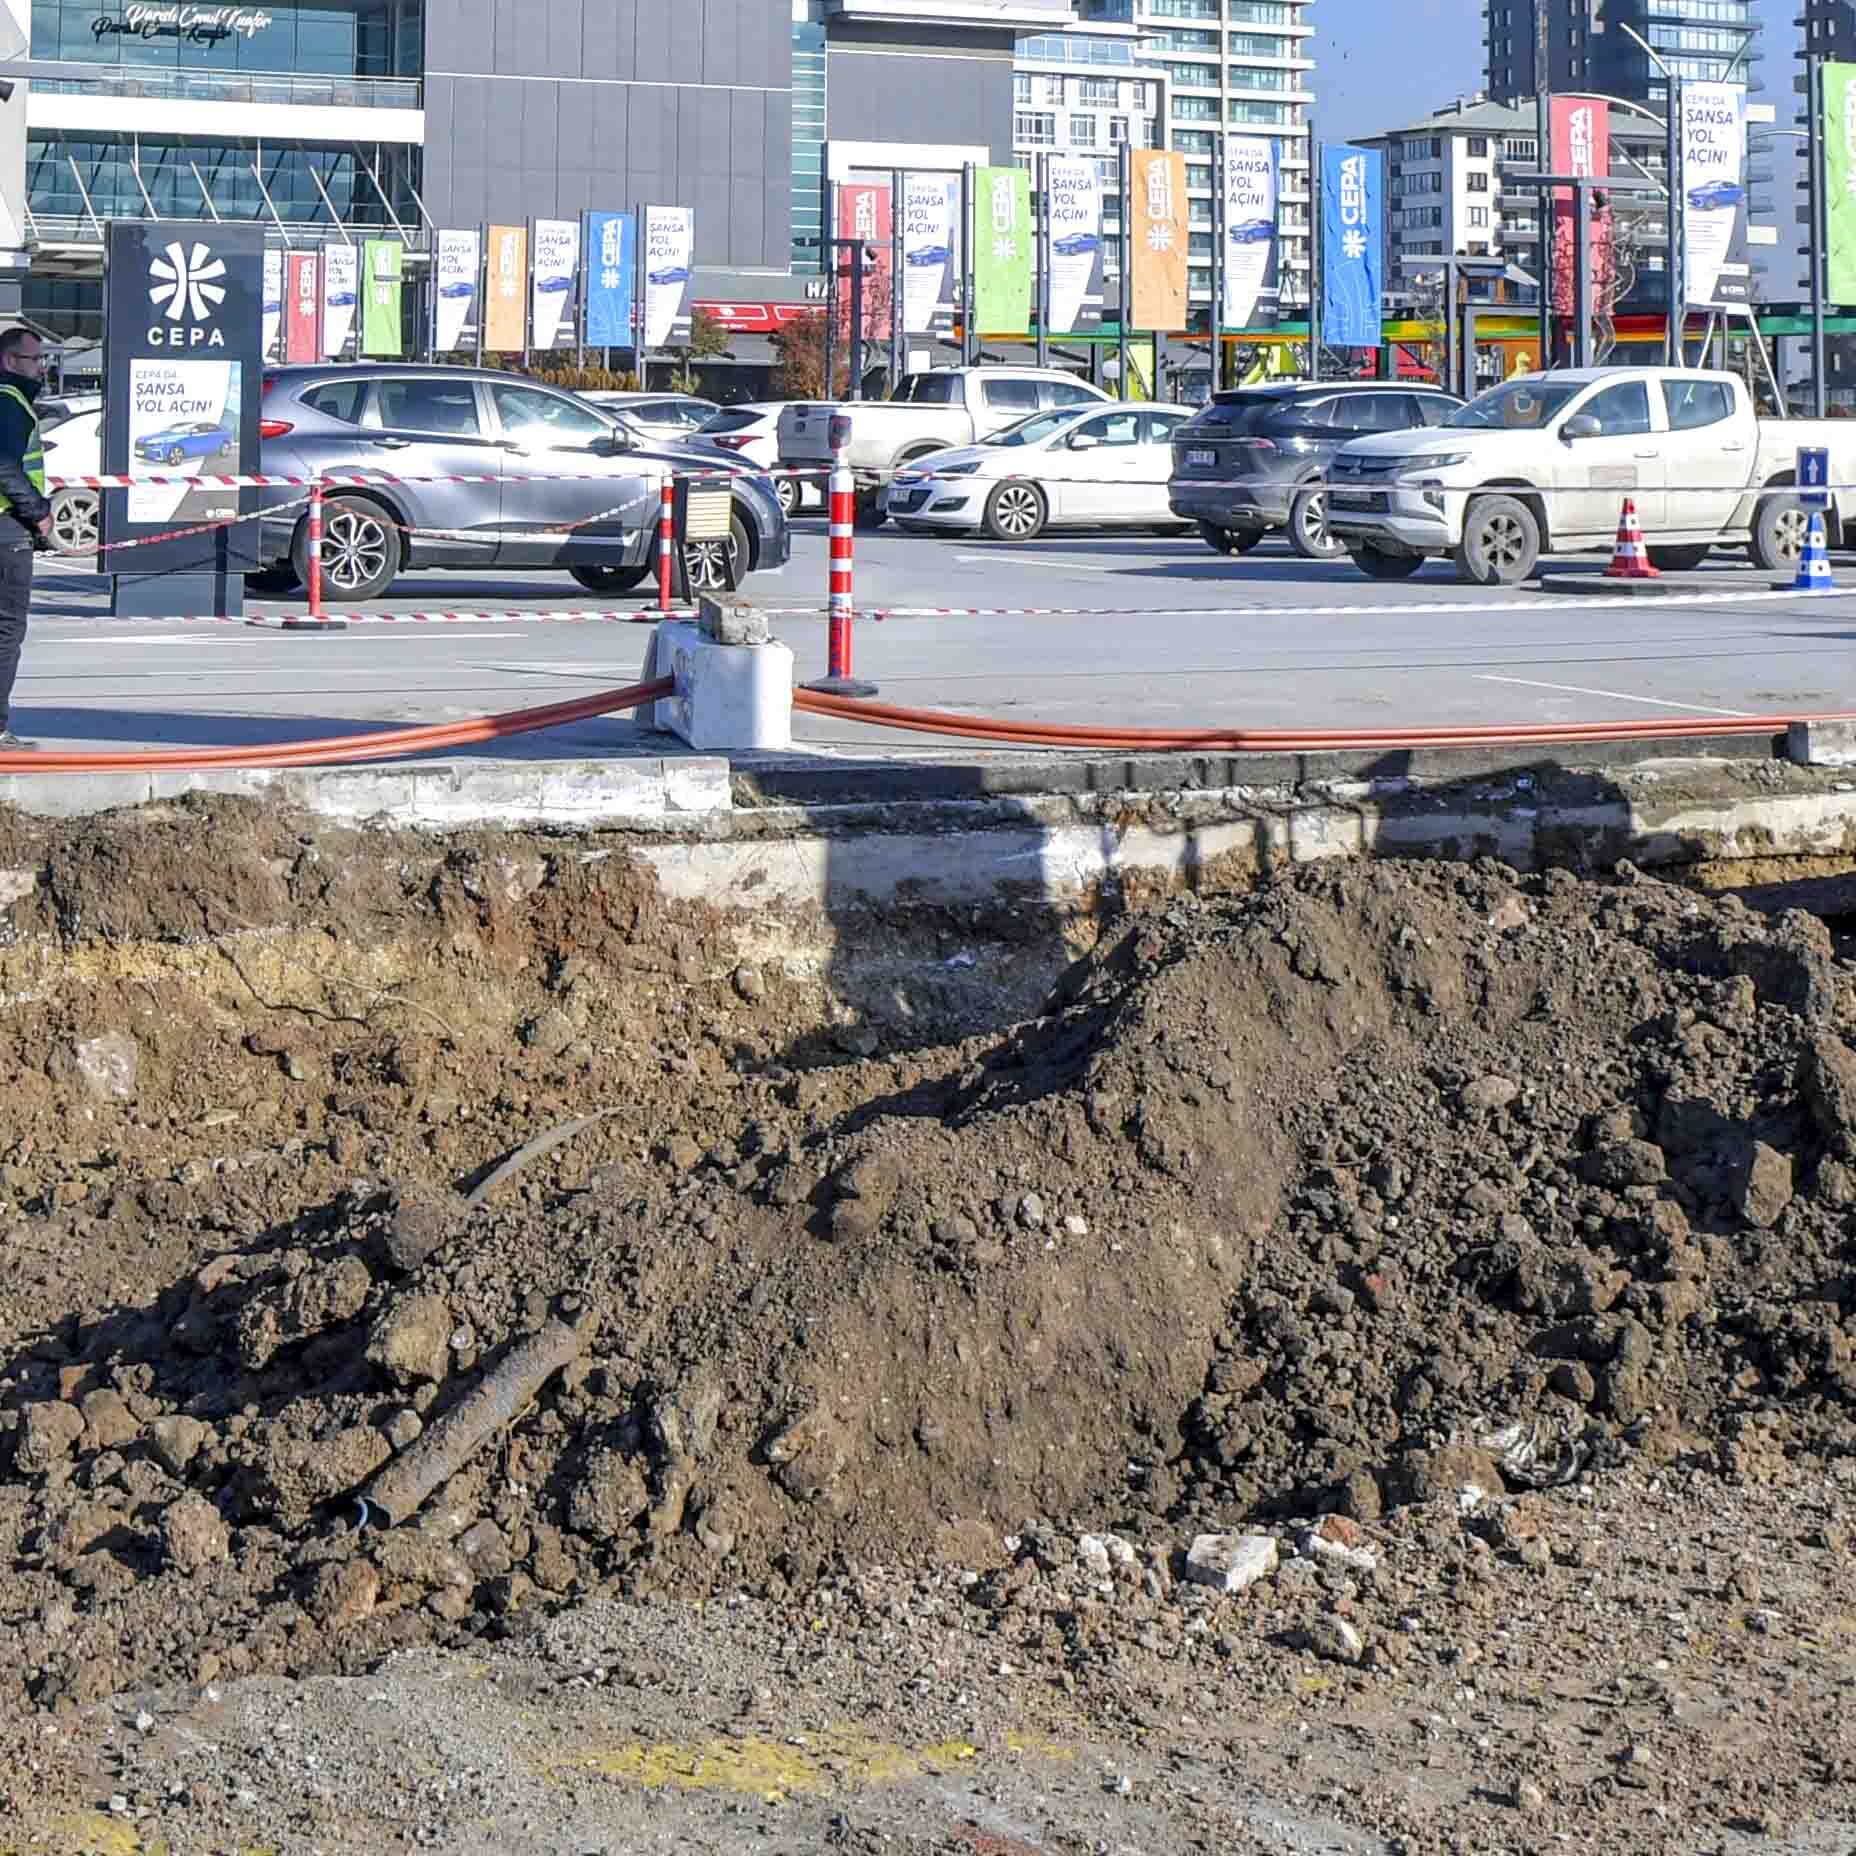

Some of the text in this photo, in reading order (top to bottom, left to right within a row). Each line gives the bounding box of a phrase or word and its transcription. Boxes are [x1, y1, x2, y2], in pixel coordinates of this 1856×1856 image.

[1685, 108, 1734, 126] ŞANSA
[1686, 128, 1717, 144] YOL
[1685, 148, 1728, 167] AÇIN!
[1228, 159, 1271, 174] ŞANSA
[1051, 177, 1093, 192] ŞANSA
[1148, 159, 1166, 220] CEPA
[1229, 175, 1254, 189] YOL
[1340, 155, 1359, 225] CEPA
[906, 194, 944, 208] ŞANSA
[1052, 193, 1077, 205] YOL
[1228, 191, 1265, 208] AÇIN!
[906, 209, 929, 220] YOL
[1051, 208, 1088, 224] AÇIN!
[906, 222, 940, 235] AÇIN!
[649, 234, 670, 245] YOL
[147, 325, 225, 347] CEPA
[135, 382, 185, 399] ŞANSA
[135, 399, 213, 416] YOL AÇIN!
